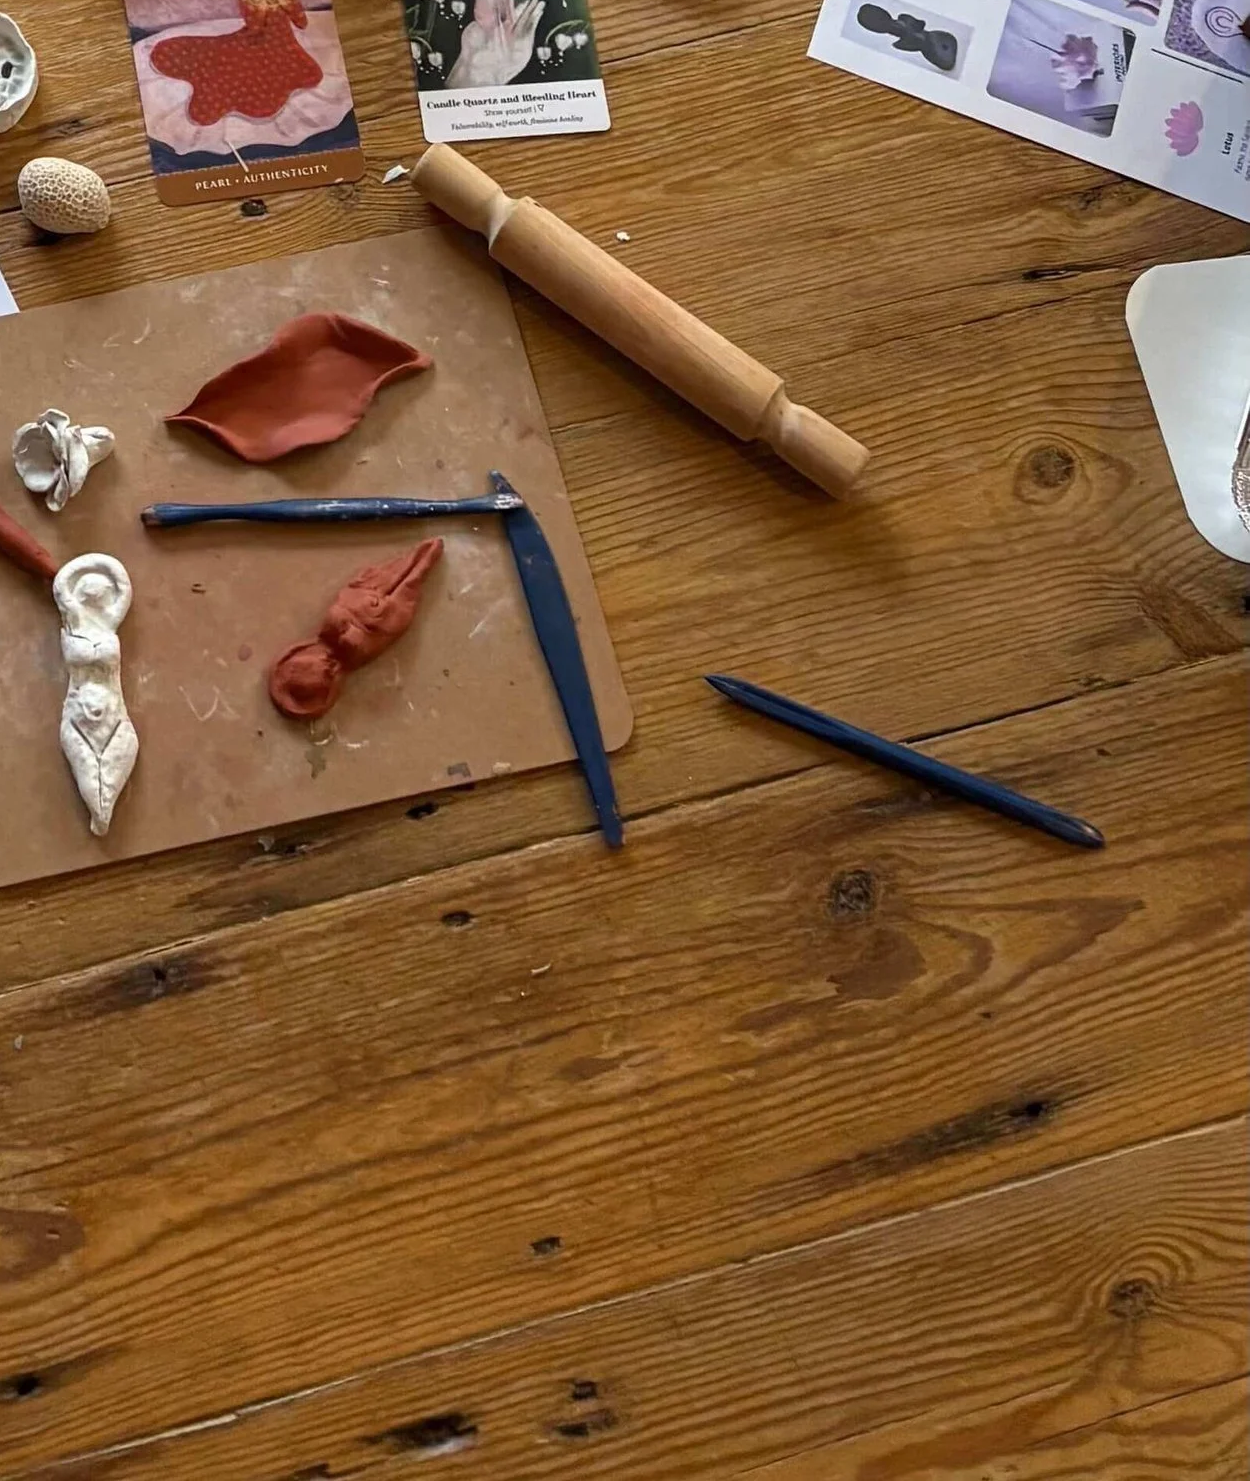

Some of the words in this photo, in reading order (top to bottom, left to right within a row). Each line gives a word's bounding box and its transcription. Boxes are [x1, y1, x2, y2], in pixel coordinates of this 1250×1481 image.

[426, 98, 460, 110] Candle
[463, 96, 498, 109] Quartz
[500, 94, 519, 104] and
[522, 91, 565, 103] Bleeding
[567, 89, 597, 100] Heart
[1222, 132, 1234, 155] Lotus
[195, 177, 231, 191] PEARL
[243, 164, 329, 184] AUTHENTICITY
